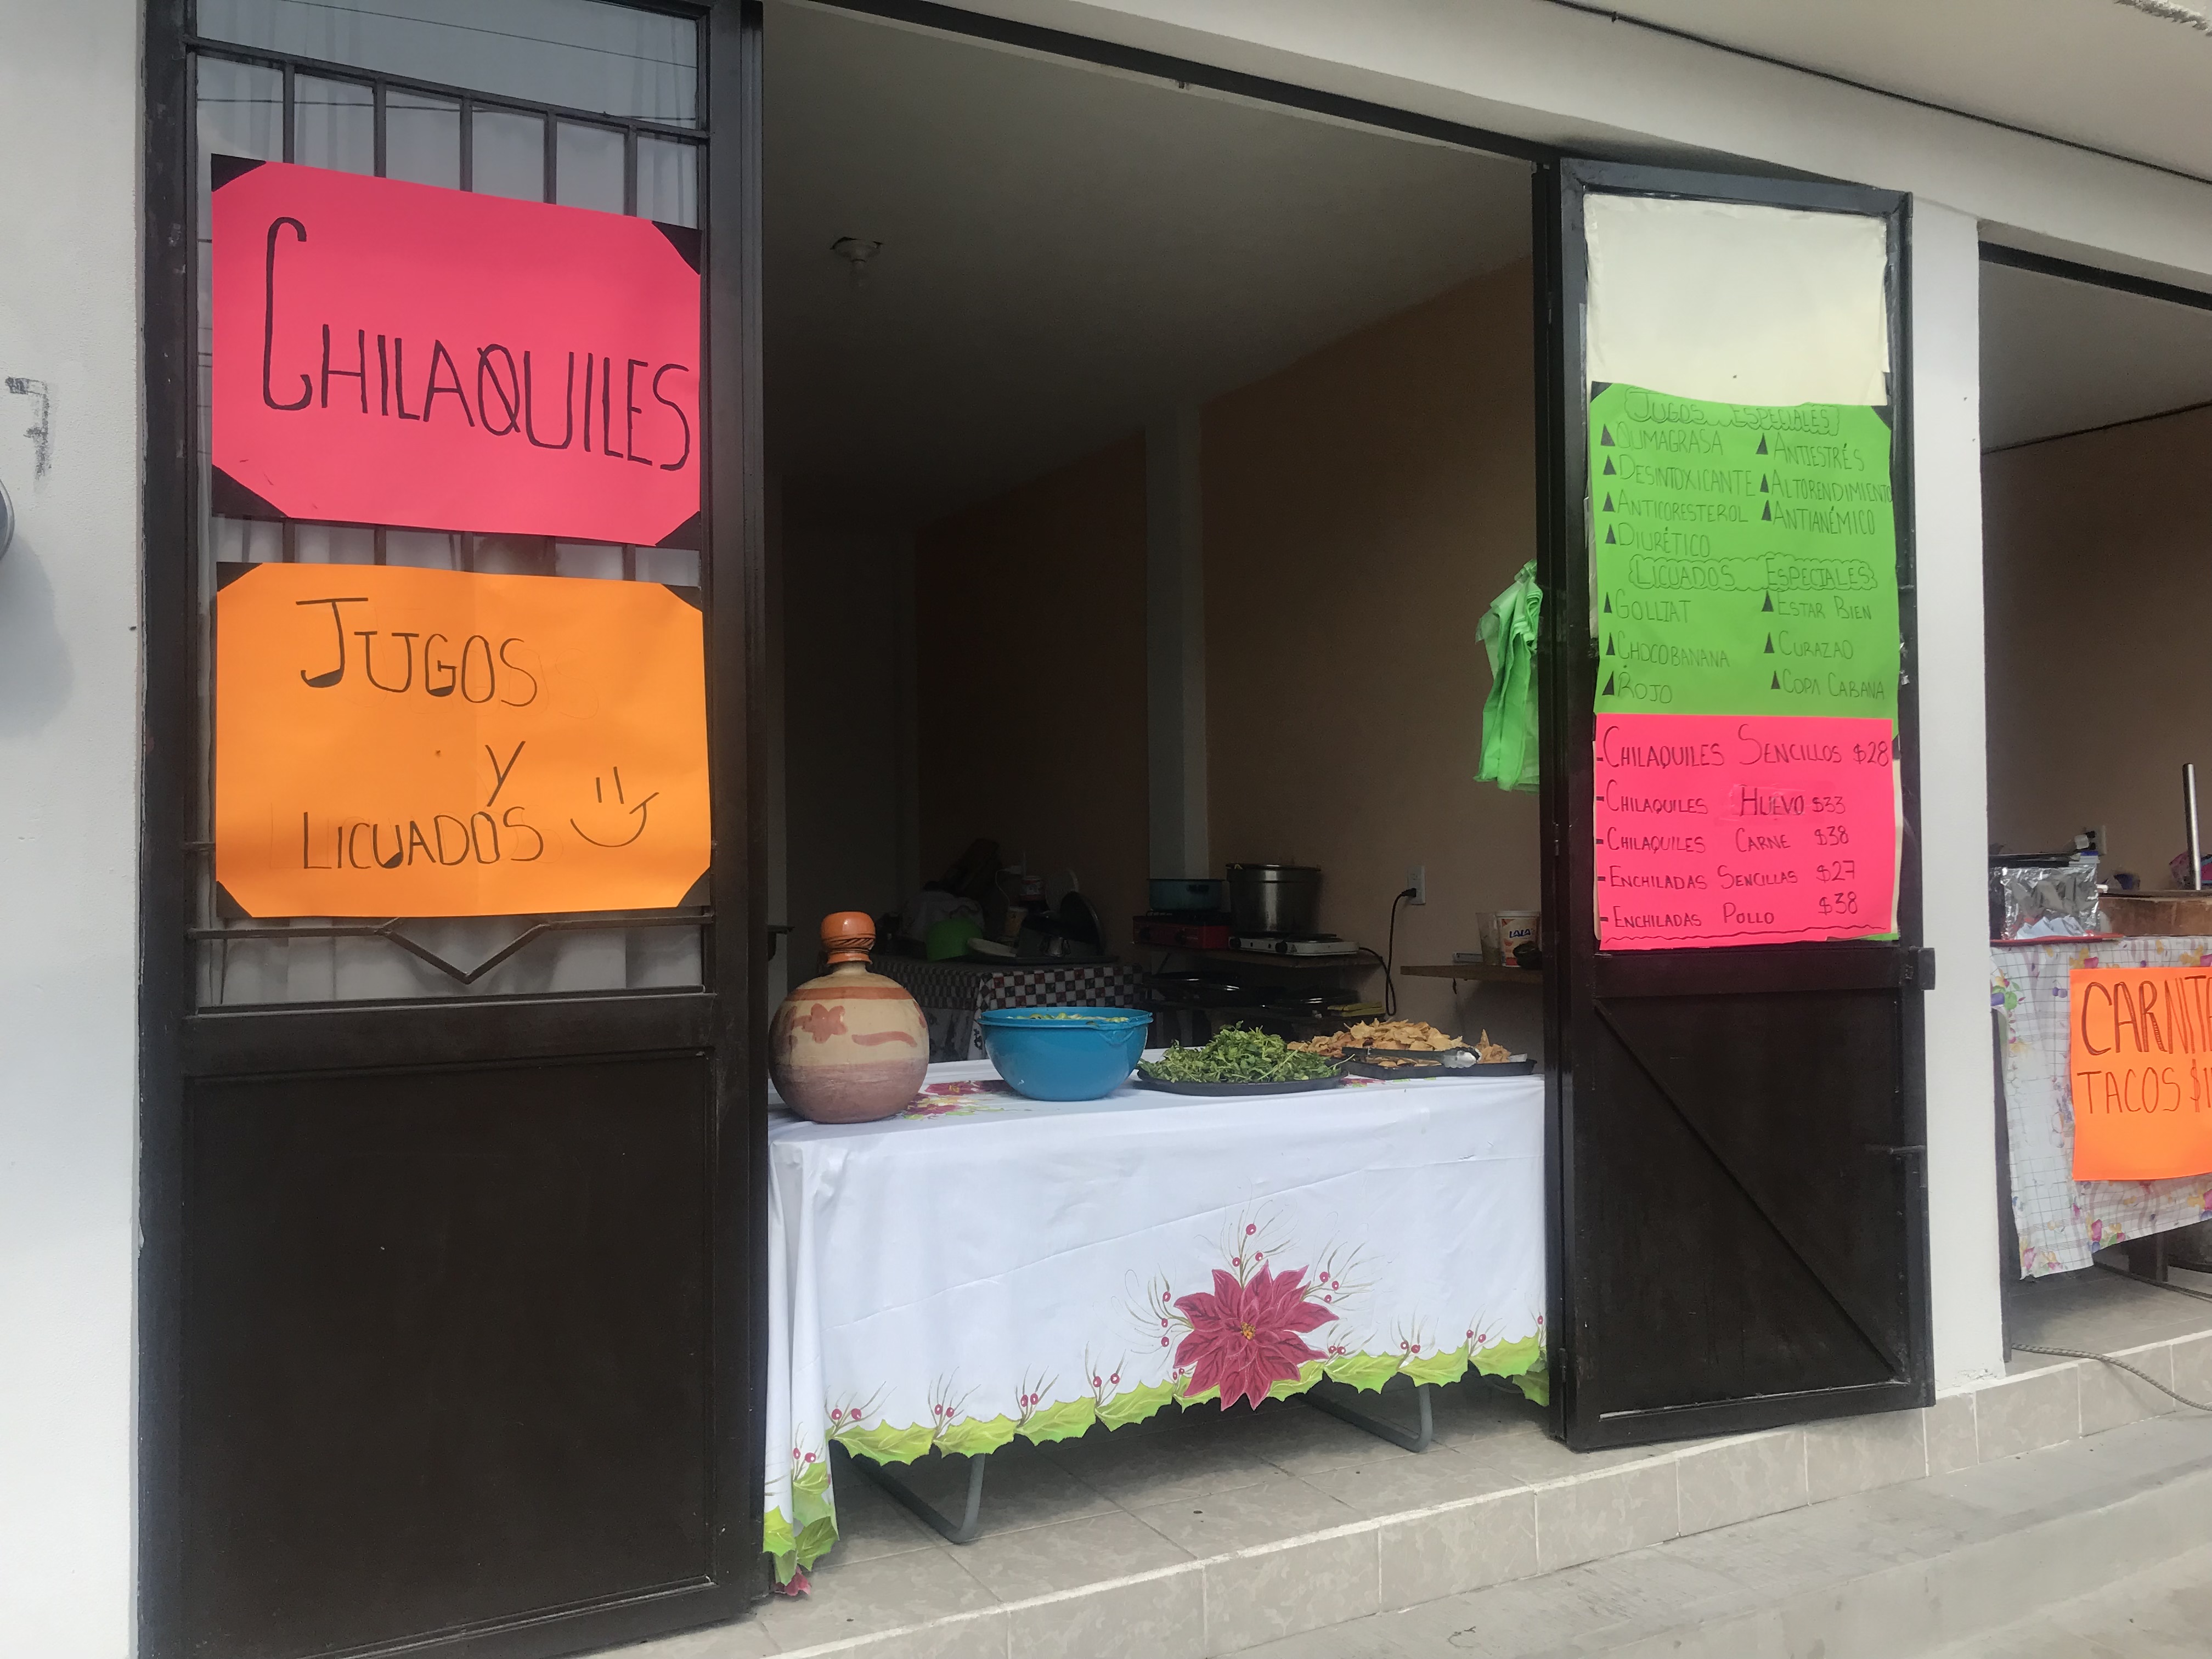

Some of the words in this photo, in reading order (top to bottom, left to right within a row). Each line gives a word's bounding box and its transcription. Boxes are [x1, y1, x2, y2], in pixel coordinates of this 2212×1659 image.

[263, 216, 691, 471] CHILAQUILES
[1629, 391, 1705, 422] JUGOS
[1730, 404, 1830, 430] ESPECIALES
[1773, 432, 1865, 471] ANTIESTRÉS
[1618, 454, 1756, 496] DESINTOXICANTE
[1617, 489, 1748, 522] ANTICORESTEROL
[1773, 500, 1875, 535] ANTIANÉMICO
[1618, 522, 1710, 557] DIURÉTICO
[1635, 559, 1735, 587] LICUADOS
[1766, 557, 1871, 587] ESPECIALES
[1615, 588, 1692, 623] GOLLIAT
[1776, 590, 1826, 619] ESTAR
[1833, 596, 1872, 620] BIEN
[296, 597, 538, 708] JUGOS
[1617, 630, 1730, 668] CHOCOBANANA
[1778, 630, 1854, 660] CURAZAO
[1617, 671, 1673, 704] ROJO
[1782, 668, 1822, 695] COPA
[1827, 672, 1886, 701] CABANA
[1737, 723, 1842, 766] SENCILLOS
[1853, 741, 1890, 768] $28
[1738, 784, 1805, 817] HUEVO
[1812, 795, 1846, 815] $33
[302, 805, 544, 870] LICUADOS
[1735, 827, 1792, 853] CARNE
[1814, 825, 1849, 847] $38
[1717, 864, 1798, 890] SENCILLAS
[1816, 860, 1855, 883] $27
[1722, 902, 1775, 924] POLLO
[1818, 891, 1859, 915] $38
[1509, 928, 1531, 938] LALA
[2077, 1066, 2181, 1114] TACOS
[2190, 1058, 2212, 1113] $1
